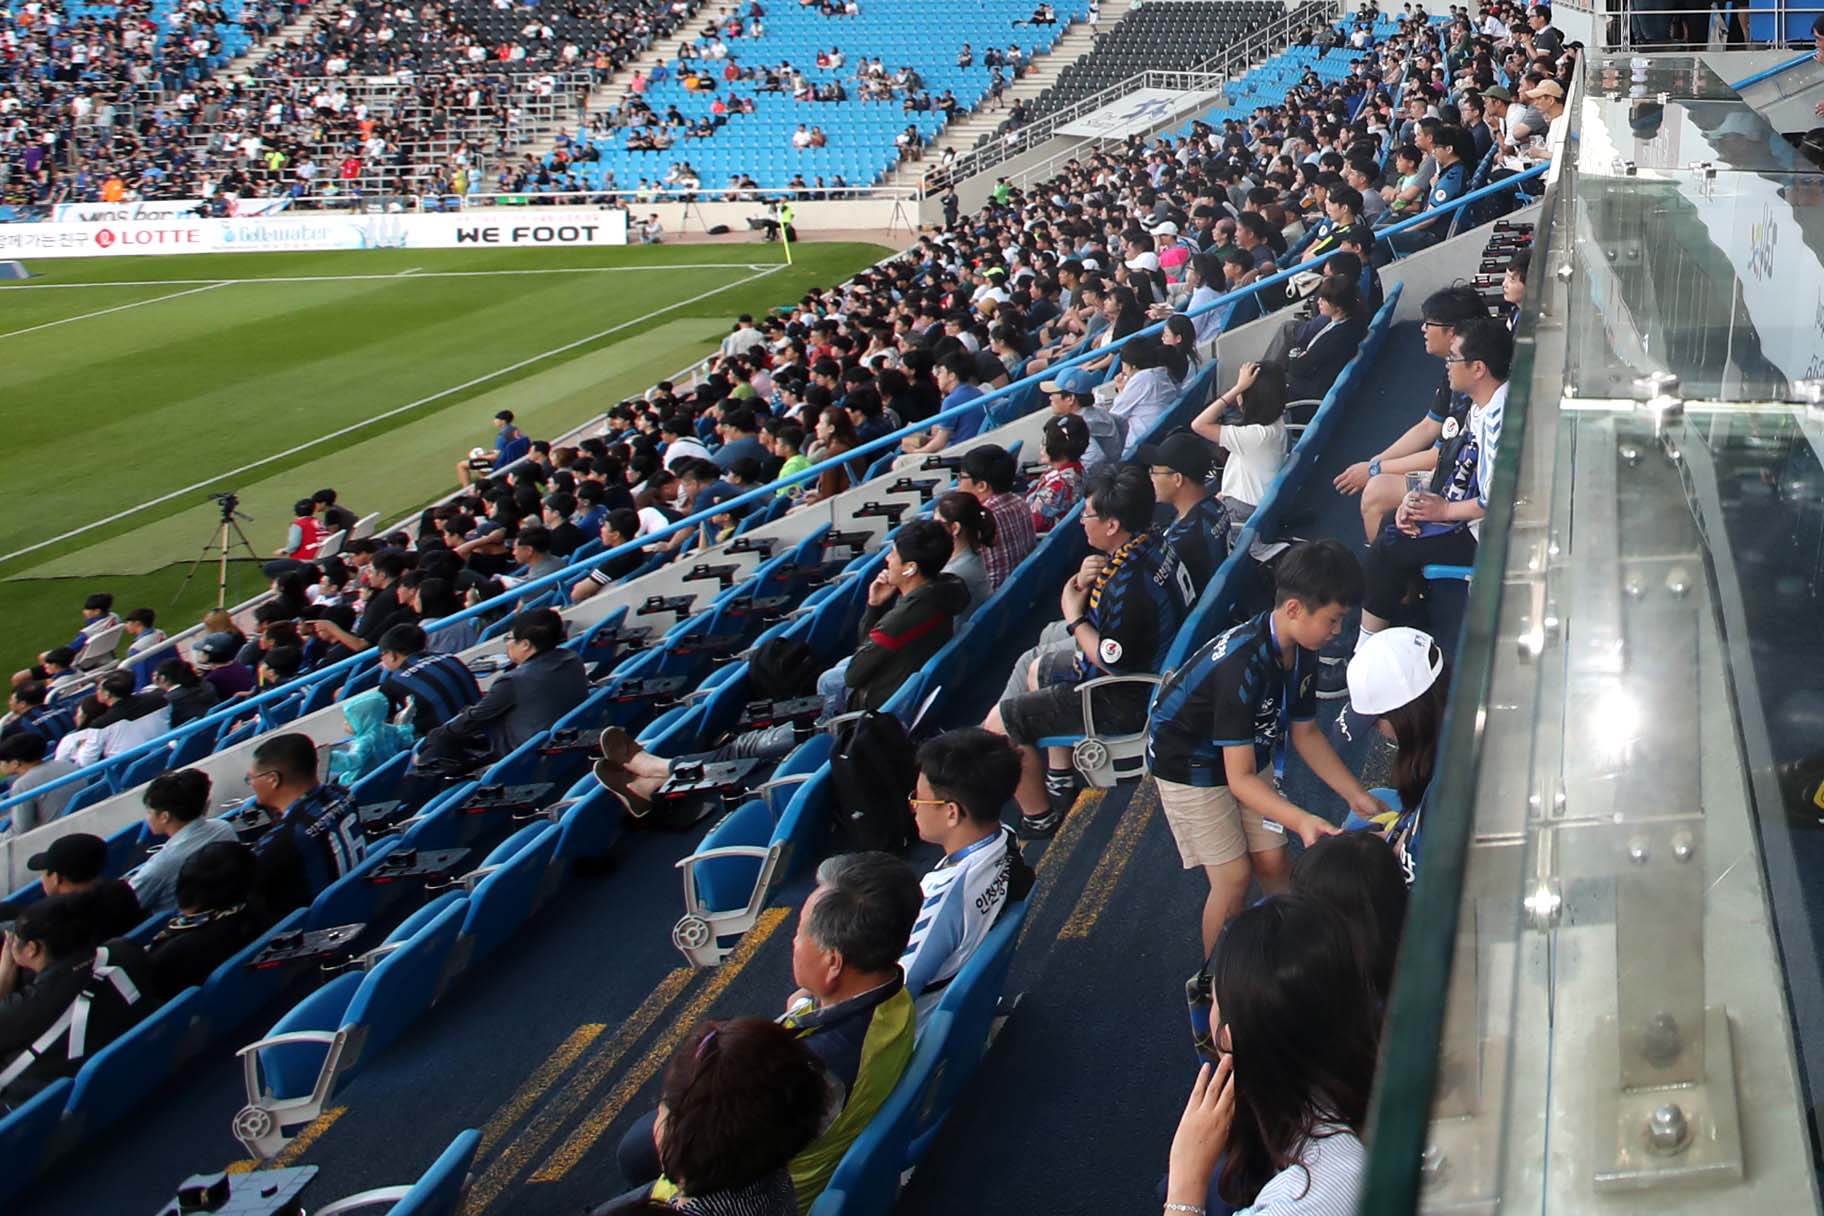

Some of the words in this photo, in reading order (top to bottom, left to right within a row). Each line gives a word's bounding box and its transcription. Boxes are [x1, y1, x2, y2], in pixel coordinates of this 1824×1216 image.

[60, 232, 89, 248] 친구
[121, 229, 201, 245] LOTTE
[456, 227, 500, 243] WE
[512, 225, 599, 242] FOOT
